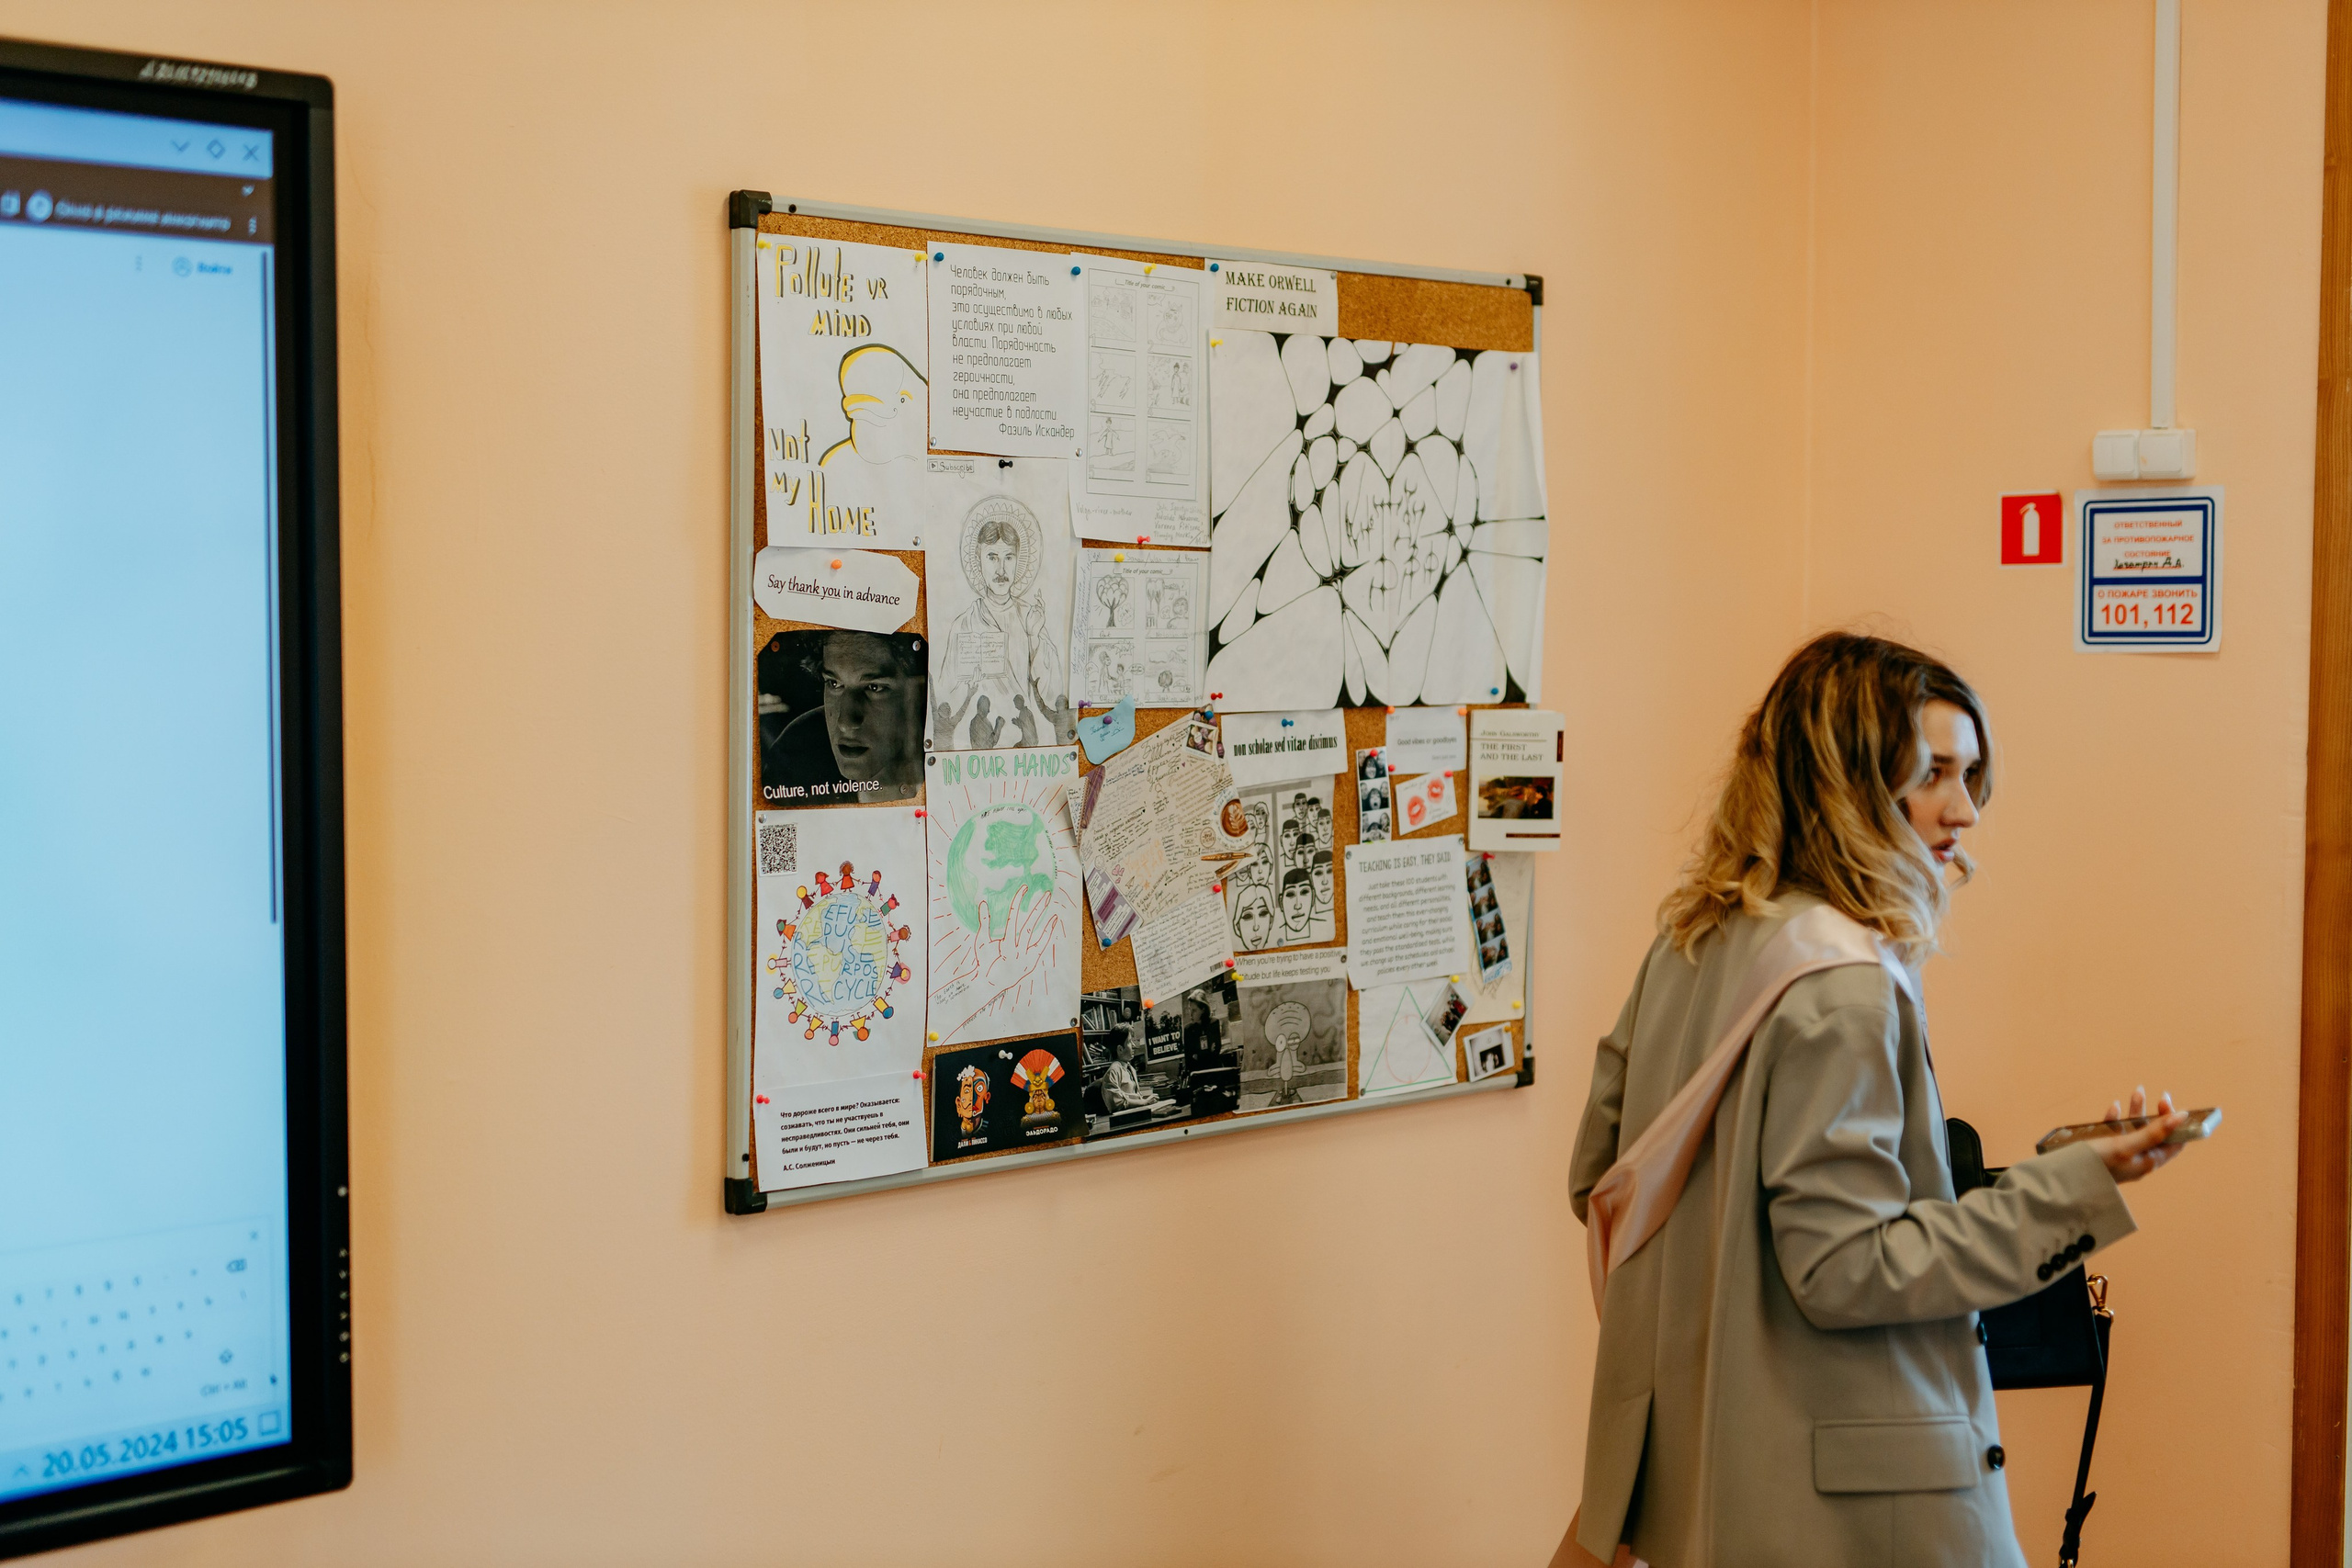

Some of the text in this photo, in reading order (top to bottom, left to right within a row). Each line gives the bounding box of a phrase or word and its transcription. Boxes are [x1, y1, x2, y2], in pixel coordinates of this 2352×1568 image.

[950, 265, 1049, 286] Человек должен быть
[1226, 271, 1316, 292] MAKE ORWELL
[951, 283, 1007, 300] порядочным,
[952, 302, 1073, 321] это осуществимо в любых
[1227, 297, 1317, 318] FICTION AGAIN
[952, 318, 1044, 336] условиях при любой
[952, 333, 1056, 353] власти. Порядочность
[953, 353, 1032, 368] не предполагает
[953, 371, 1015, 386] героичности,
[953, 387, 1037, 402] она предполагает
[953, 405, 1057, 421] неучастие в подлости.
[999, 423, 1075, 440] Фазиль Искандер
[939, 460, 973, 471] Subscribe
[2114, 519, 2183, 529] ОТВЕТСТВЕННЫЙ
[2102, 535, 2195, 545] ЗА ПРОТИВОПОЖАРНОЕ
[768, 574, 900, 605] Say thank you in advance
[2098, 588, 2198, 599] О ПОЖАРЕ ЗВОНИТЬ
[2101, 603, 2194, 629] 101, 112
[1233, 733, 1338, 757] non scholae sed vitae discimus
[1480, 742, 1498, 750] THE
[1480, 752, 1498, 761] AND
[1521, 753, 1544, 761] LAST
[942, 752, 1071, 785] IN OUR HANDS
[763, 780, 883, 799] Culture, not violence.
[1359, 852, 1451, 873] TEACHING IS EASY, THEY SAID
[1236, 956, 1256, 966] When
[1257, 955, 1275, 967] you're
[1276, 953, 1292, 964] trying
[1299, 952, 1314, 961] have
[1319, 950, 1341, 961] positive
[1261, 971, 1272, 980] but
[1272, 970, 1281, 978] life
[1282, 968, 1298, 979] keeps
[1300, 967, 1319, 976] testing
[1320, 965, 1331, 974] you
[1152, 1033, 1170, 1044] WANT
[1170, 1031, 1181, 1041] TO
[1153, 1043, 1178, 1055] BELIEVE
[793, 1109, 817, 1119] дороже
[818, 1106, 835, 1114] всего
[840, 1102, 859, 1111] мире?
[860, 1098, 900, 1109] Оказывается:
[843, 1112, 879, 1124] участвуешь
[781, 1129, 842, 1142] несправедливостях.
[856, 1122, 881, 1133] сильней
[882, 1121, 898, 1129] тебя,
[1025, 1126, 1058, 1136] ЭЛЬДОРАДО
[782, 1146, 798, 1155] были
[804, 1144, 824, 1153] будут,
[832, 1140, 850, 1148] пусть
[865, 1135, 883, 1144] через
[795, 1159, 836, 1170] Солженицын
[41, 1416, 249, 1478] 20.05.2024 15:05
